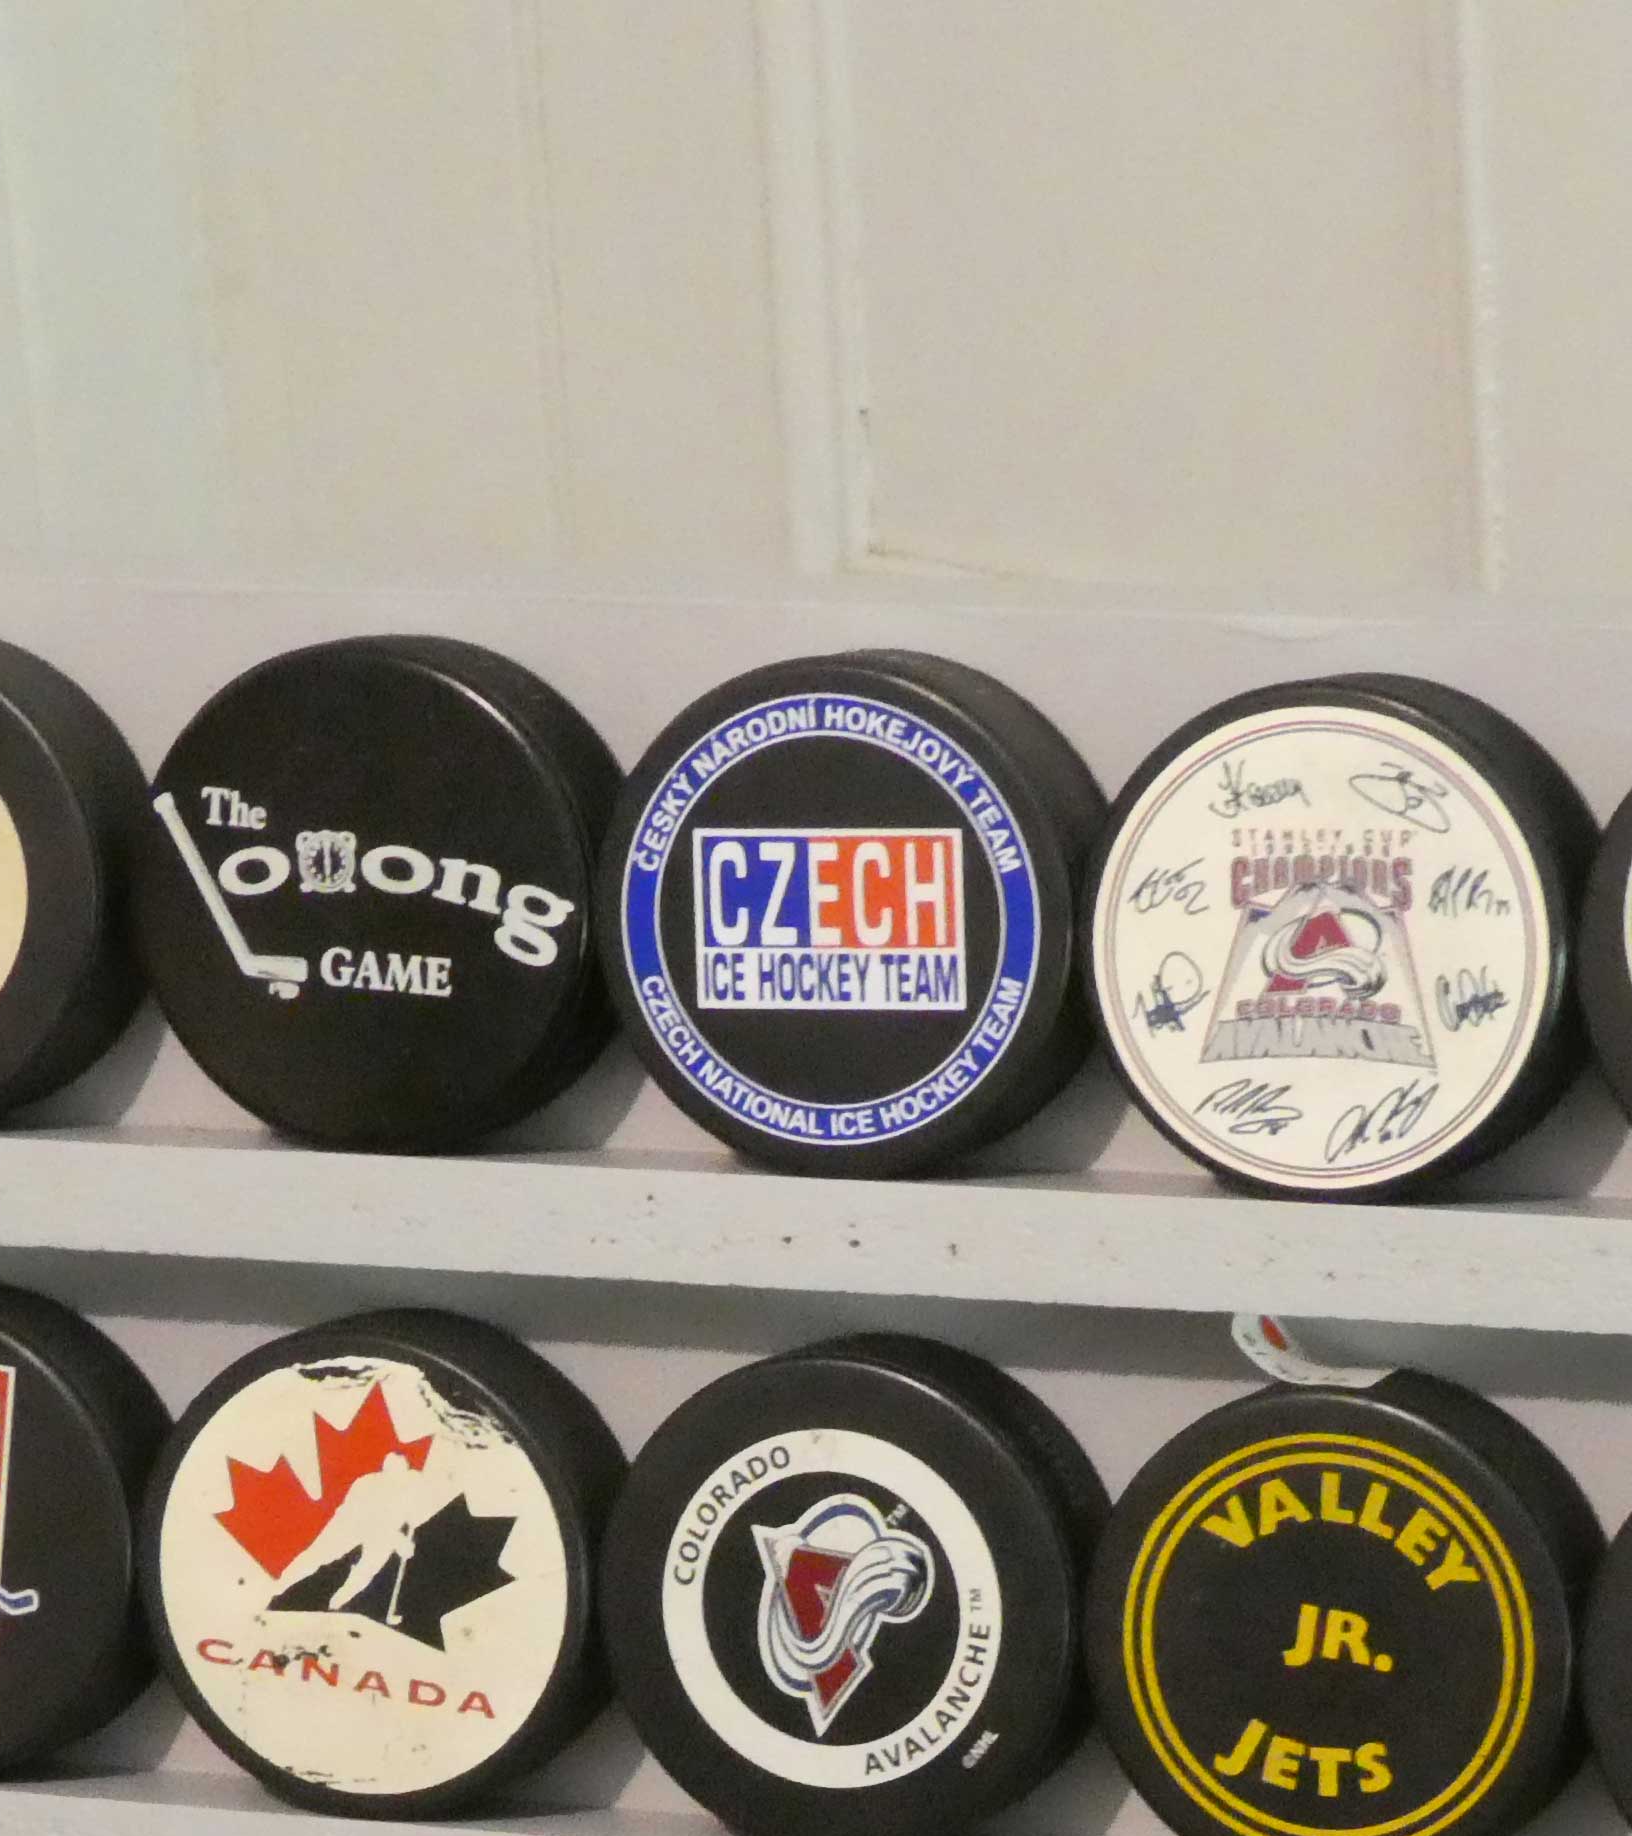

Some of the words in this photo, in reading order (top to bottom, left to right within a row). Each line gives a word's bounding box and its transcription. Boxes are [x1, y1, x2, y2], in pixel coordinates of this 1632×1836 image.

[201, 787, 267, 830] The
[969, 787, 1023, 873] TEAM
[708, 840, 947, 947] CZECH
[320, 946, 453, 998] GAME
[704, 953, 745, 1001] ICE
[759, 954, 869, 1003] HOCKEY
[882, 954, 959, 1003] TEAM
[1236, 998, 1402, 1023] COLORADO
[641, 975, 702, 1065] CZECH
[698, 1060, 824, 1136] NATIONAL
[830, 1109, 879, 1137] ICE
[878, 1049, 979, 1130] HOCKEY
[971, 976, 1024, 1053] TEAM
[674, 1445, 791, 1586] COLORADO
[1202, 1472, 1480, 1591] VALLEY
[197, 1638, 496, 1719] CANADA
[1283, 1603, 1394, 1673] JR.
[865, 1622, 992, 1776] AVALANCHE
[1214, 1718, 1394, 1797] JETS
